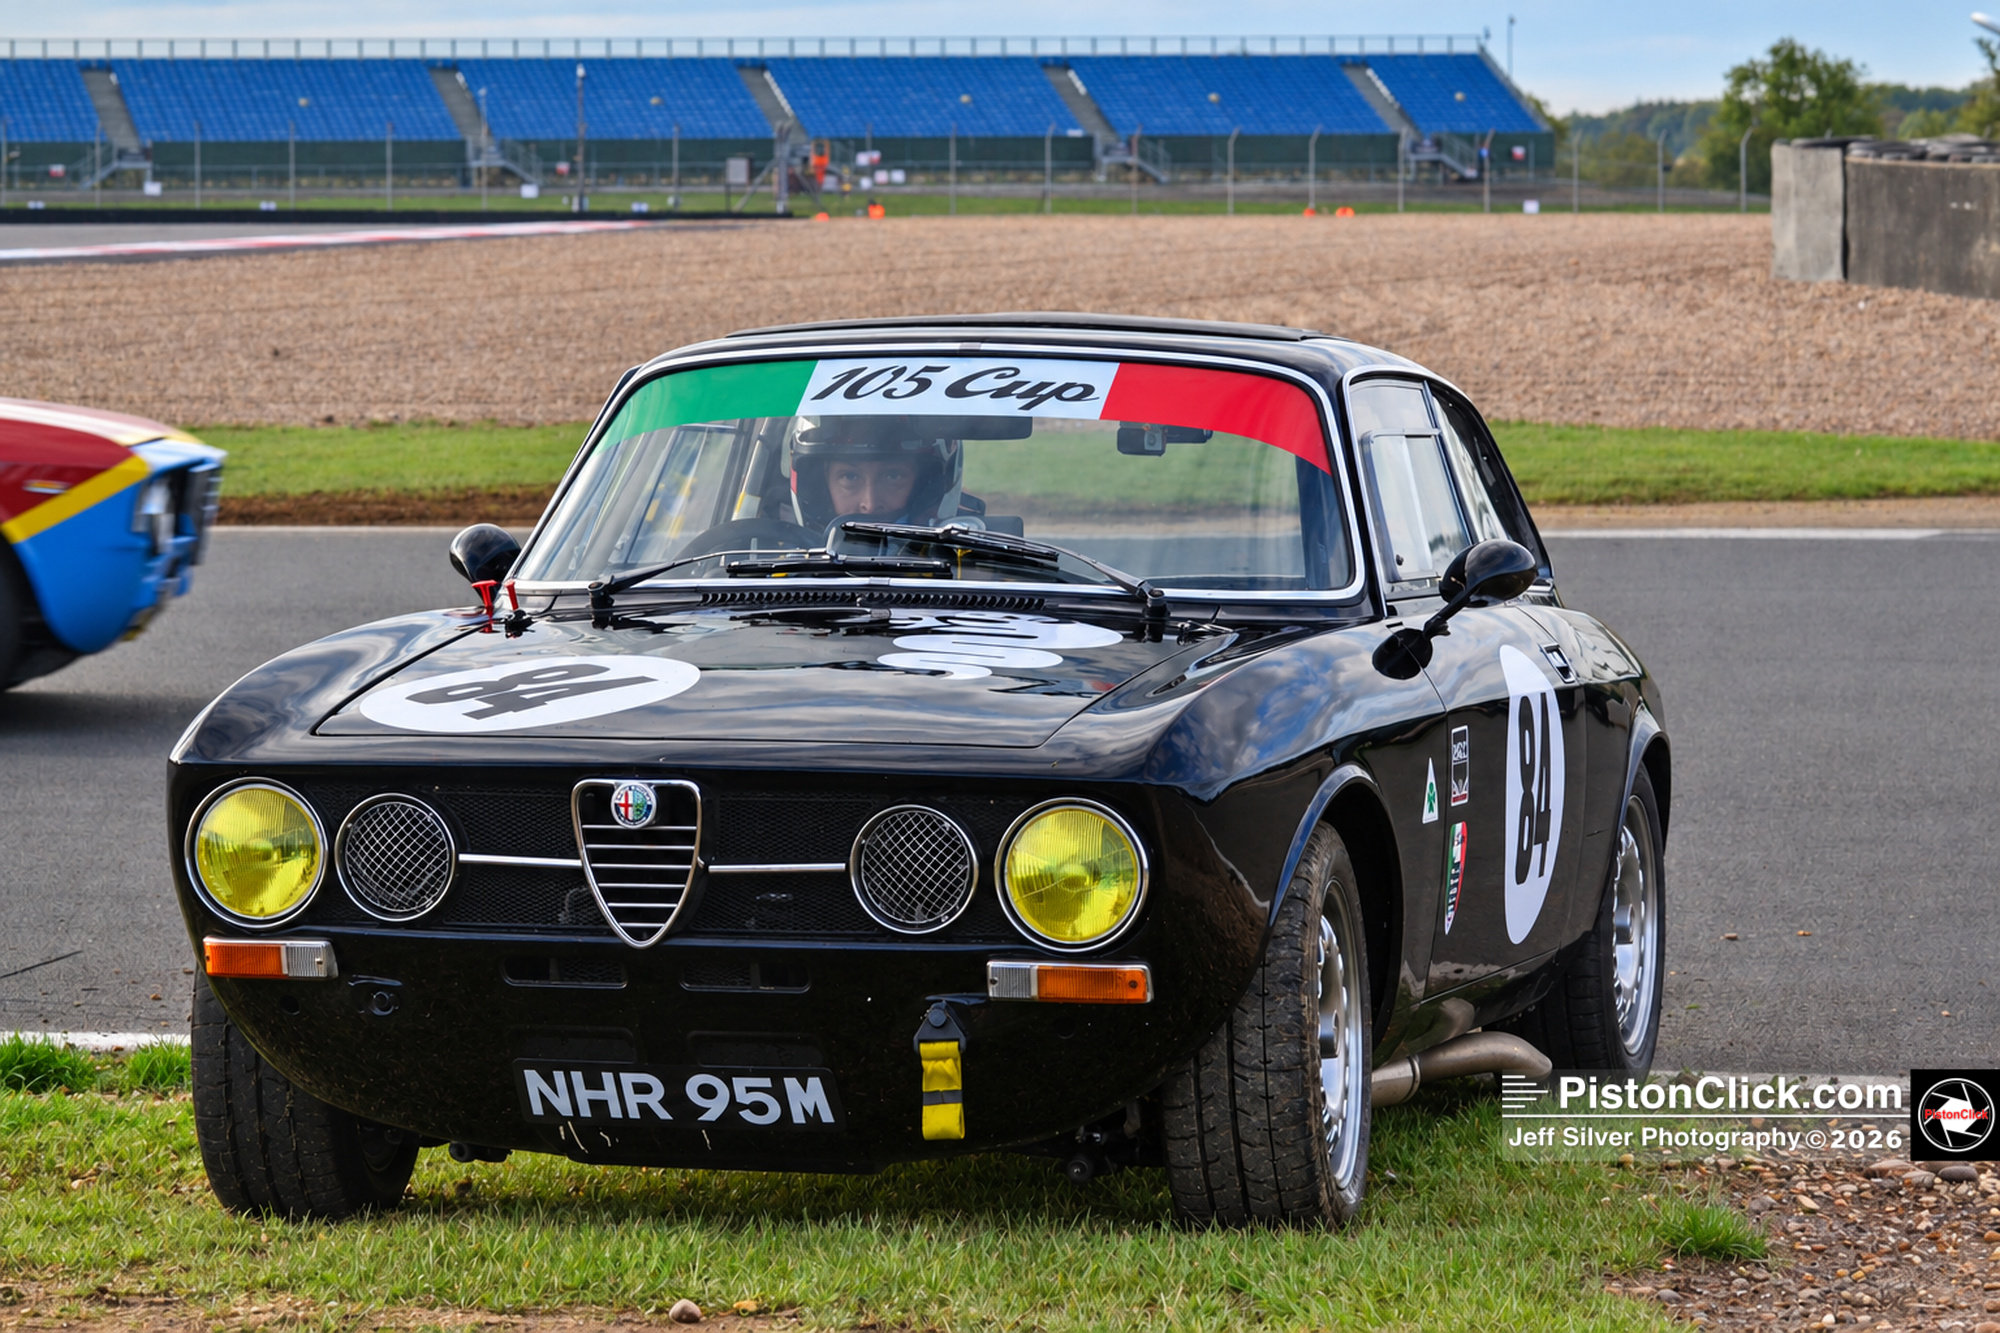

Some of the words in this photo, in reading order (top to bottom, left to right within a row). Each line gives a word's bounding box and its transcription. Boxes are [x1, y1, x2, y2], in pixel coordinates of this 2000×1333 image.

[810, 365, 950, 401] 105
[944, 366, 1100, 411] Cup
[405, 663, 659, 720] 84
[1514, 692, 1552, 886] 84
[523, 1069, 673, 1120] NHR
[685, 1073, 835, 1125] 95M
